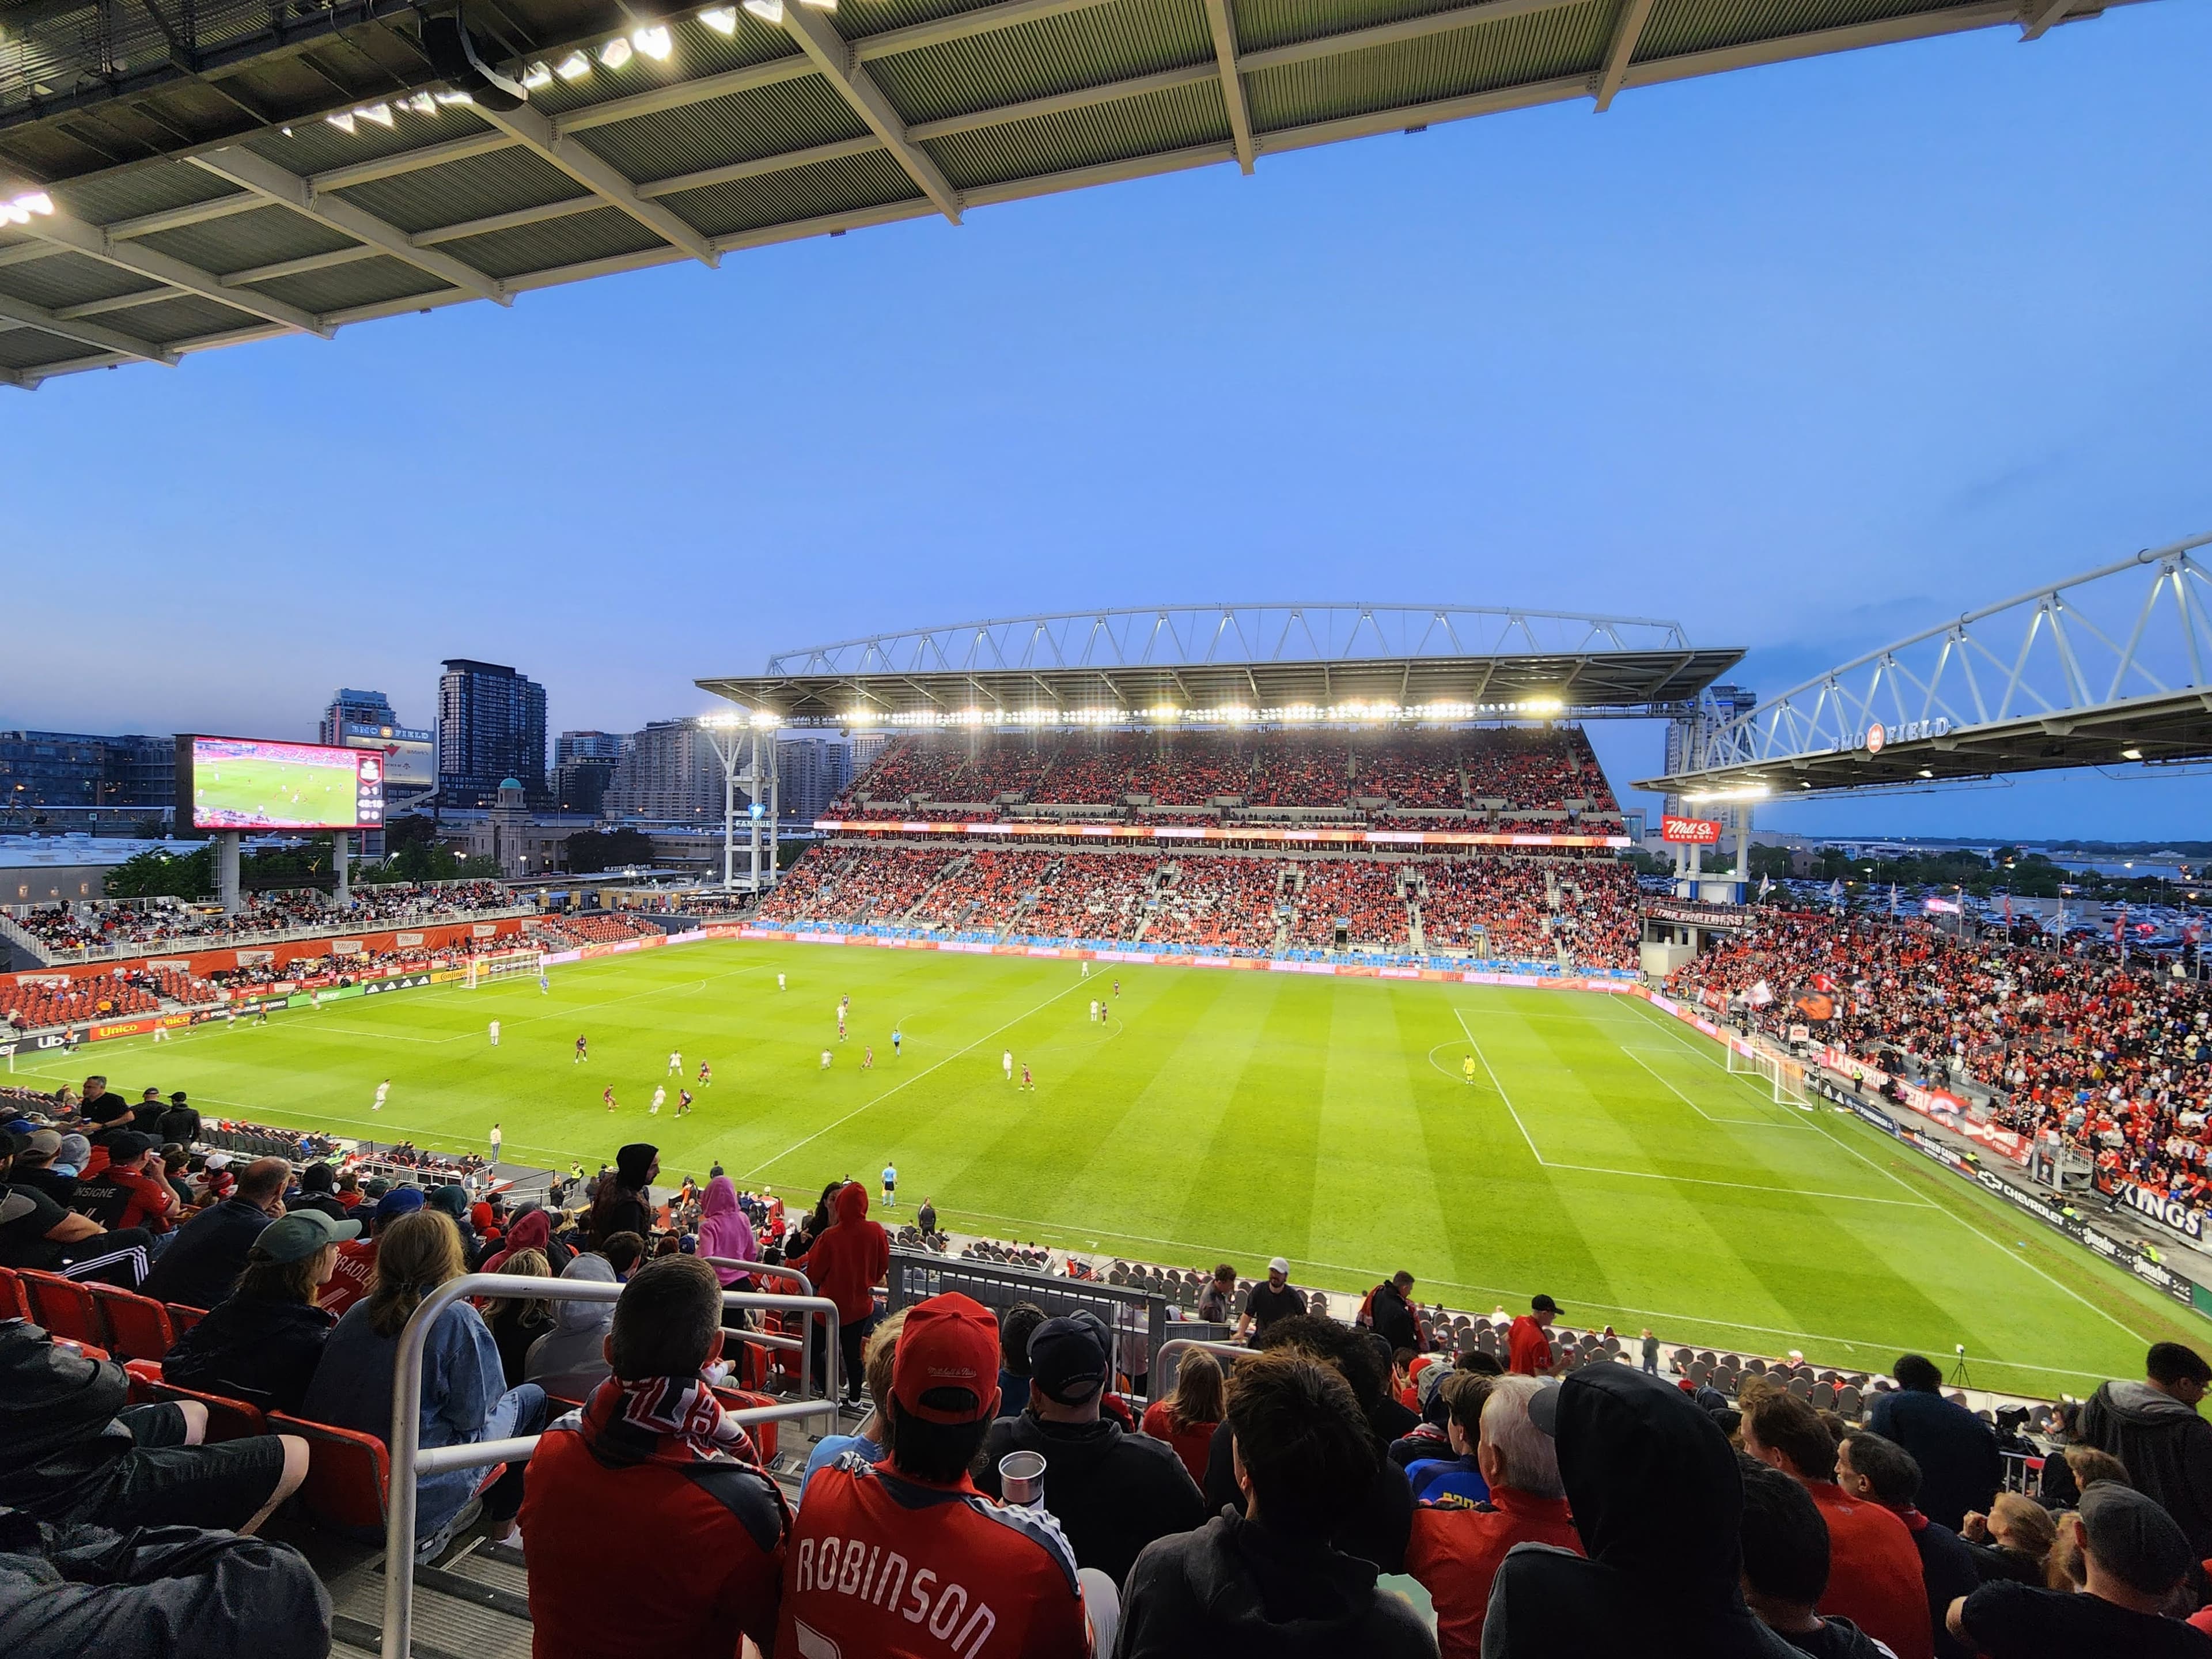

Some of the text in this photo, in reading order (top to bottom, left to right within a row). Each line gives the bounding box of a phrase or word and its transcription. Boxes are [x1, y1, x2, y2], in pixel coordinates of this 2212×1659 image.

[351, 725, 429, 739] BMO FIELD
[1831, 717, 1949, 752] BMO FIELD
[1666, 820, 1697, 834] Mill
[1657, 908, 1679, 919] THE
[1679, 912, 1744, 926] FORTRESS
[265, 1001, 286, 1009] ASINO
[165, 1015, 190, 1025] nico
[99, 1024, 138, 1037] Unico
[38, 1033, 81, 1048] Ubr
[2003, 1185, 2064, 1226] CHEVROLET
[2124, 1182, 2200, 1236] KINGS
[797, 1536, 996, 1659] ROBINSON
